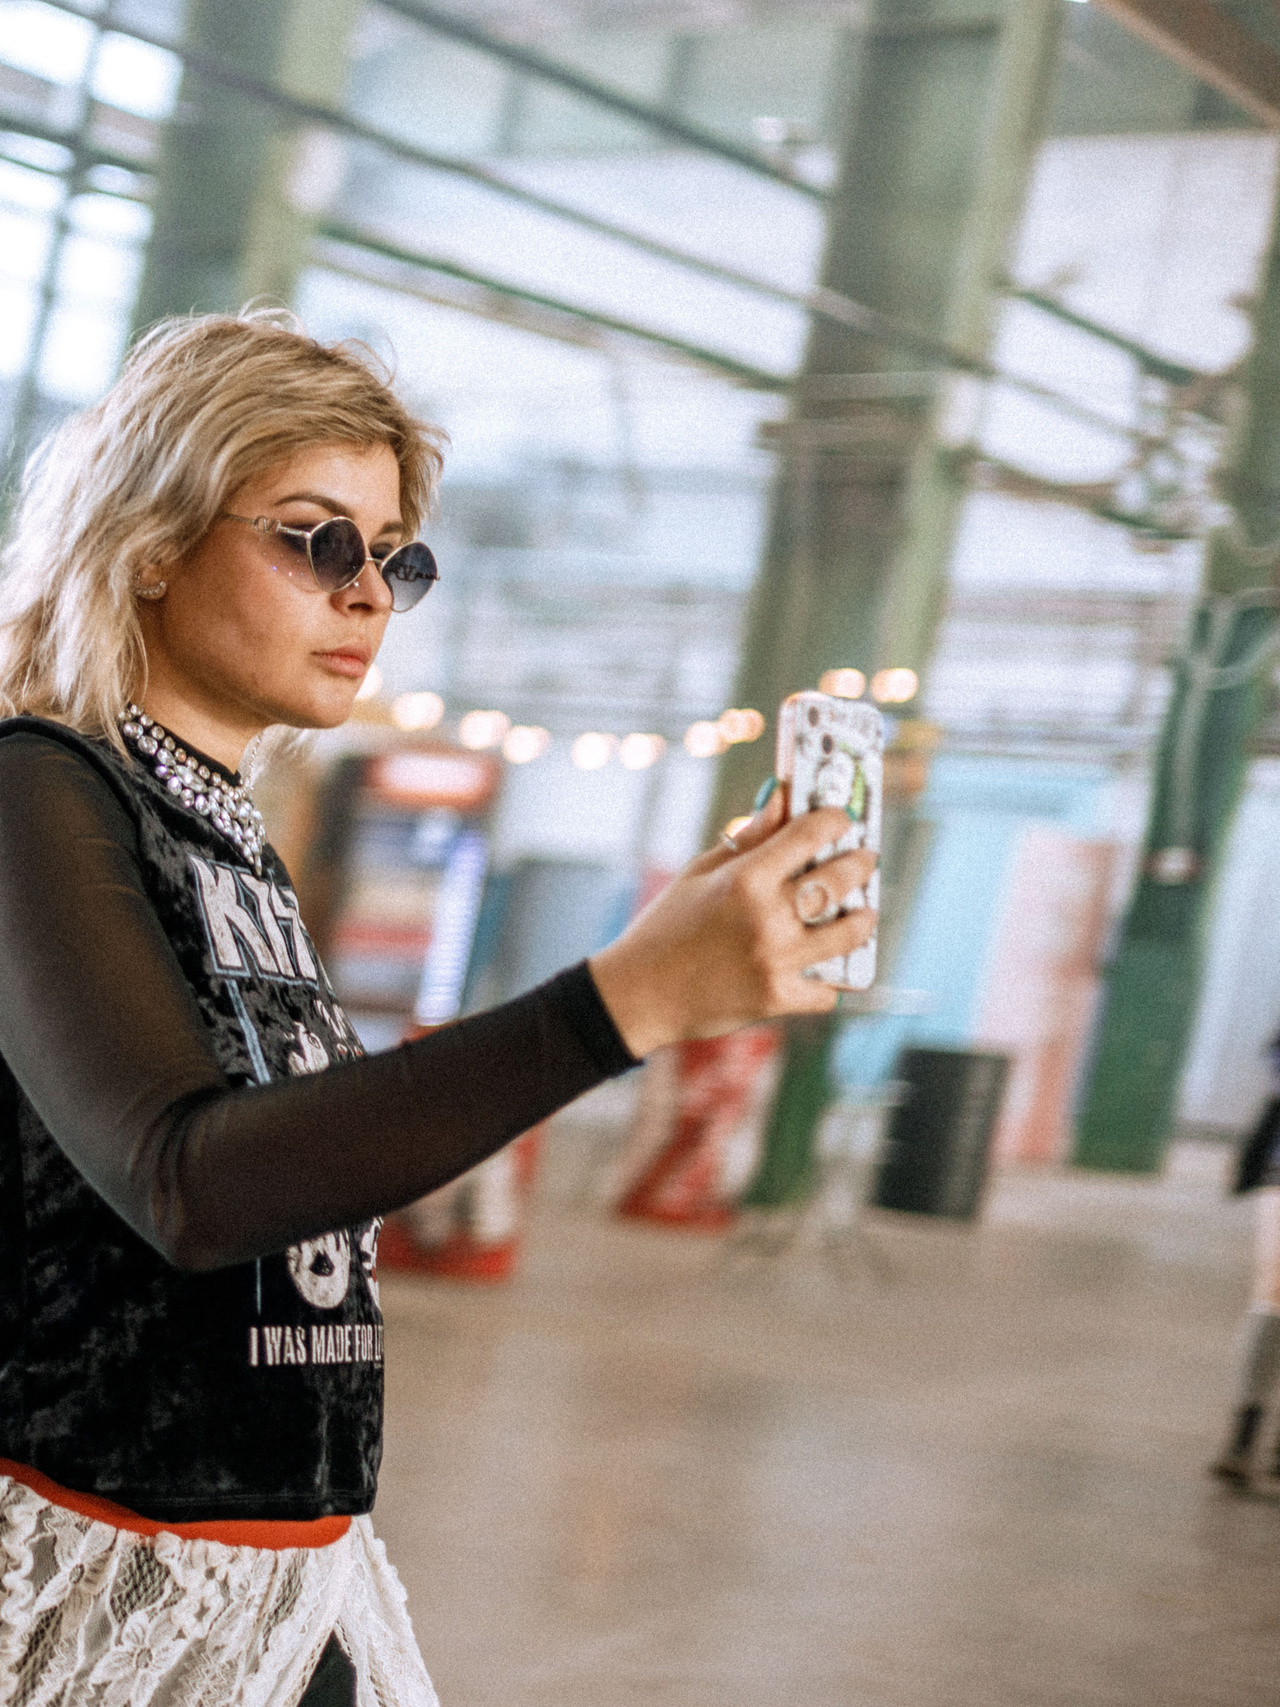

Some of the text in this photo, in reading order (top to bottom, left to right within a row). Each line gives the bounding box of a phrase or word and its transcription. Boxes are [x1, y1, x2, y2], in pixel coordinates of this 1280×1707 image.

[250, 1326, 258, 1367] I
[264, 1325, 307, 1366] WAS
[312, 1324, 352, 1364] MADE
[355, 1324, 373, 1361] FOR
